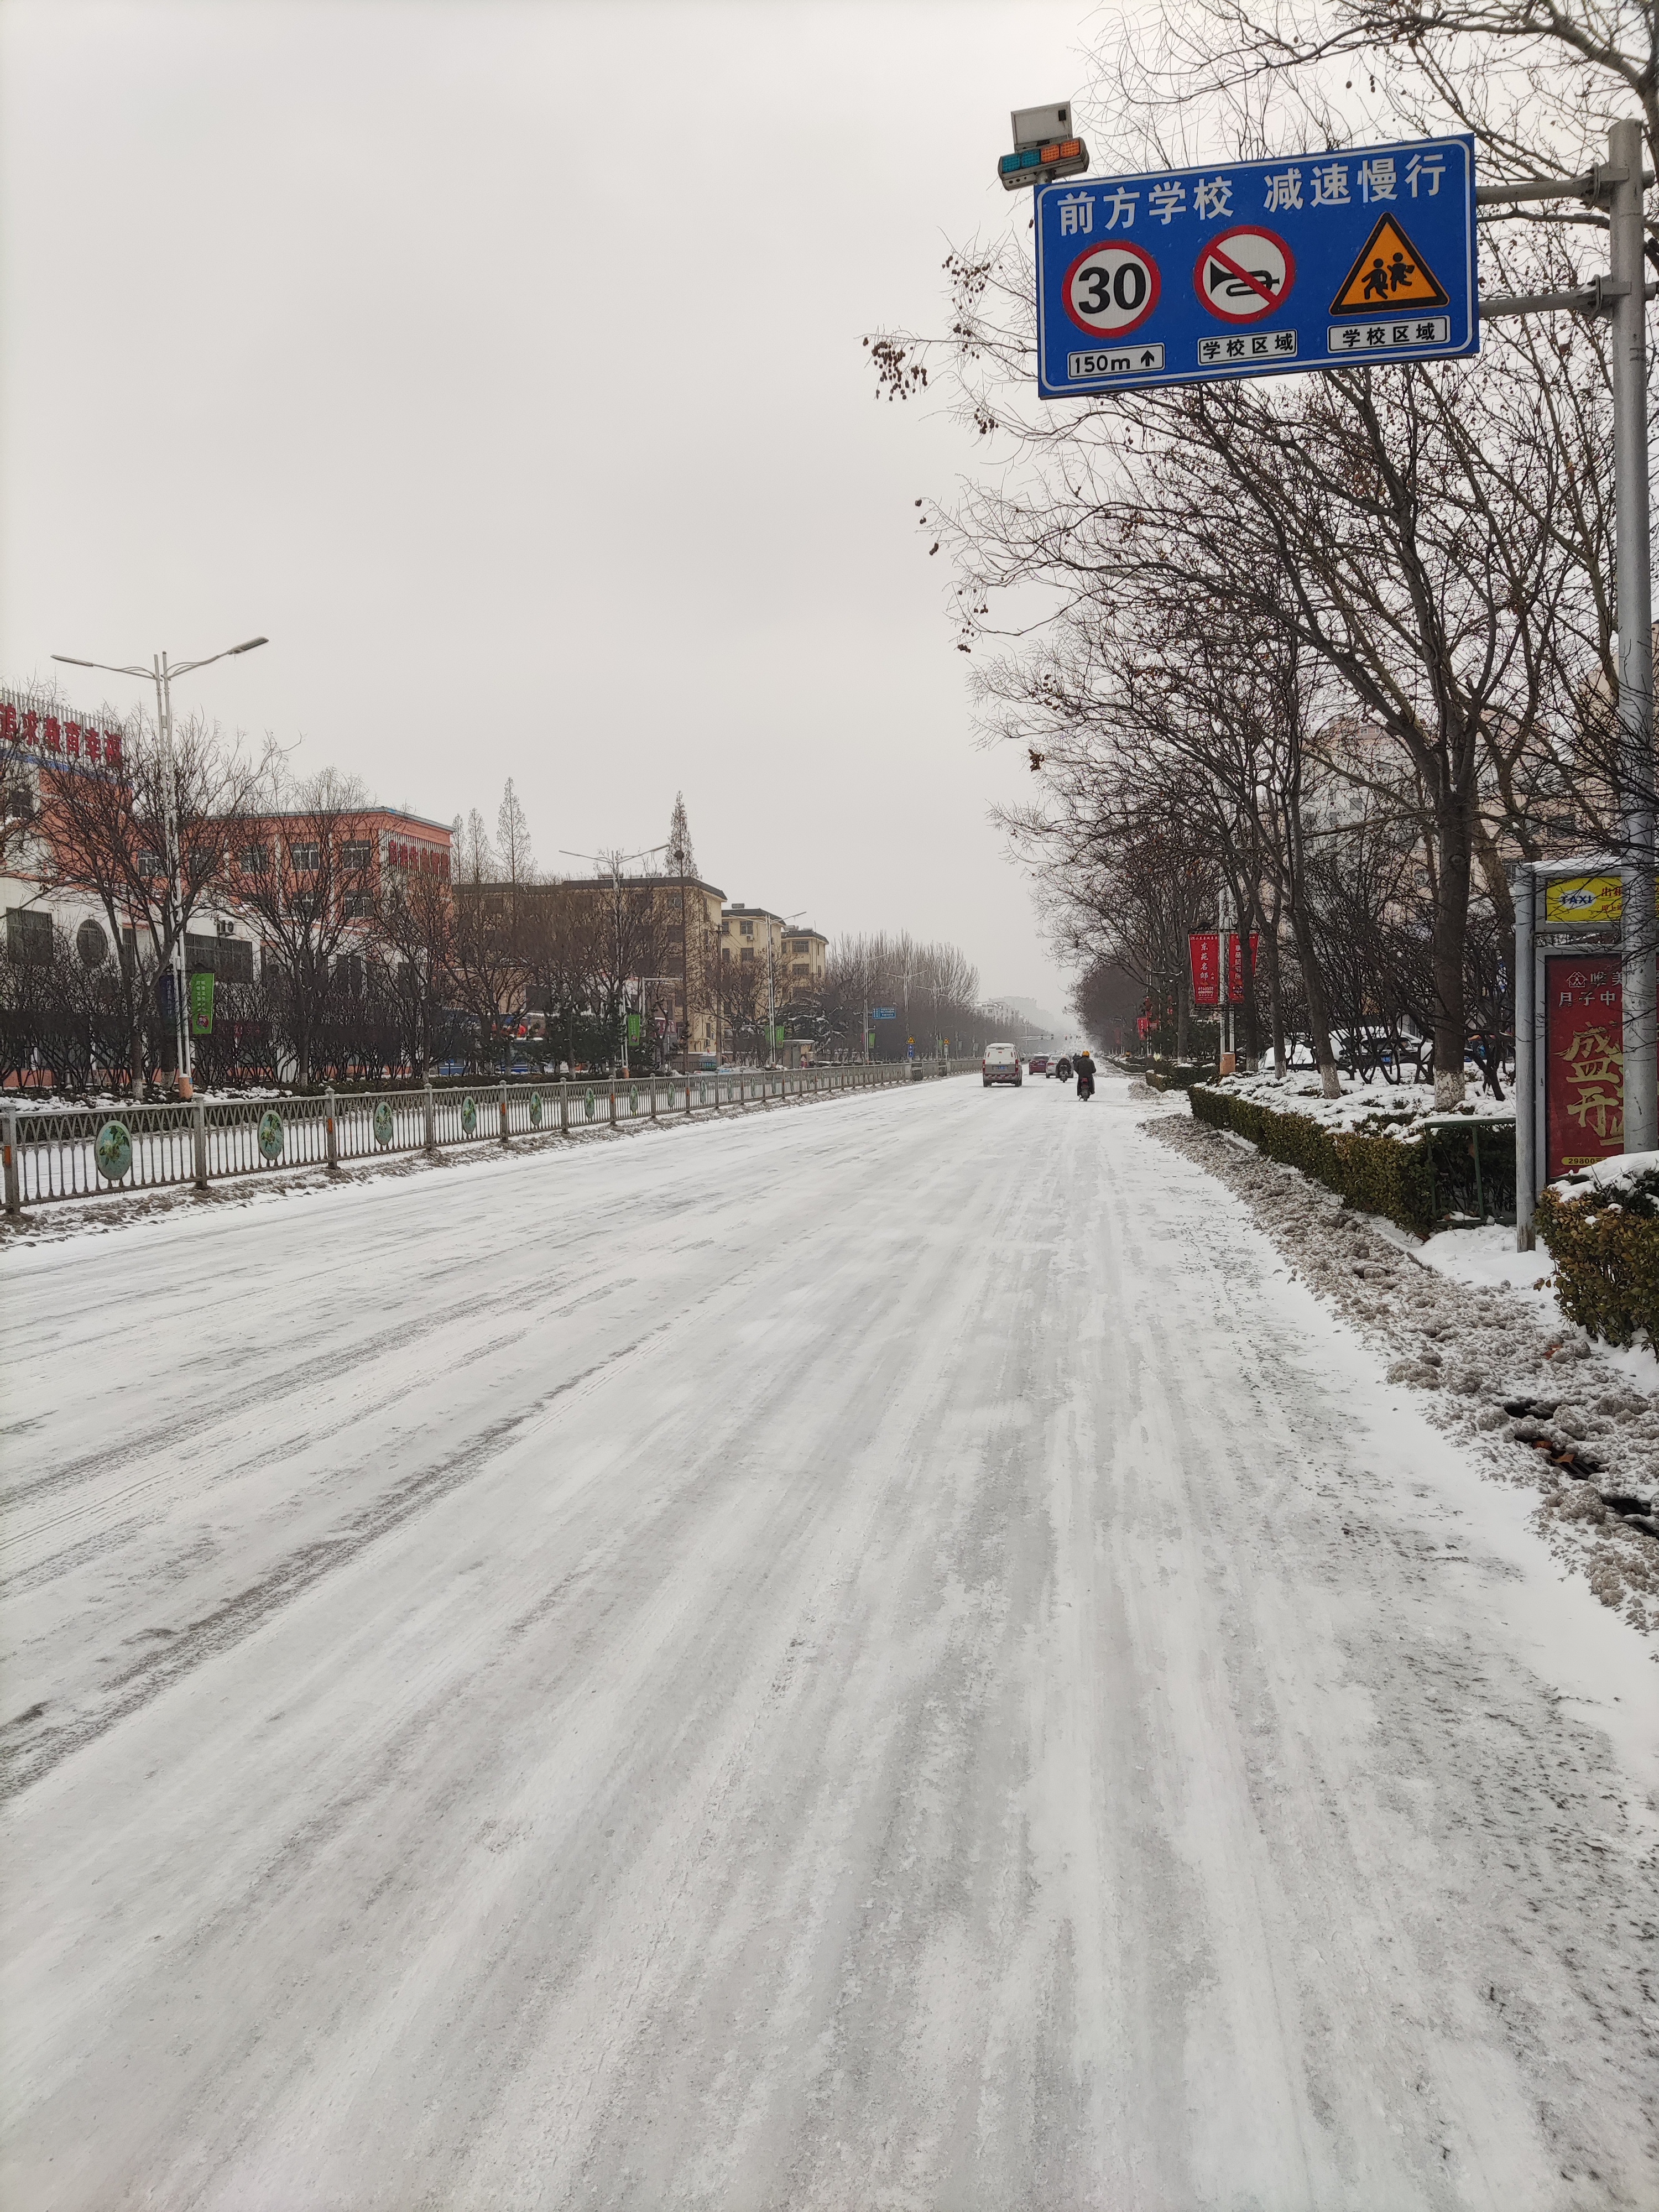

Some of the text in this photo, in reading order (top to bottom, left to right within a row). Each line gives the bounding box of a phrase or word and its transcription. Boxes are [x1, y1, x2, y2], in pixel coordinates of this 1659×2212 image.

[1057, 154, 1446, 236] 前方学校 减速慢行
[1078, 263, 1146, 314] 30
[1203, 334, 1293, 359] 学校区域
[1343, 322, 1435, 347] 学校区域
[1076, 354, 1130, 374] 150m
[1561, 895, 1592, 904] TAXI
